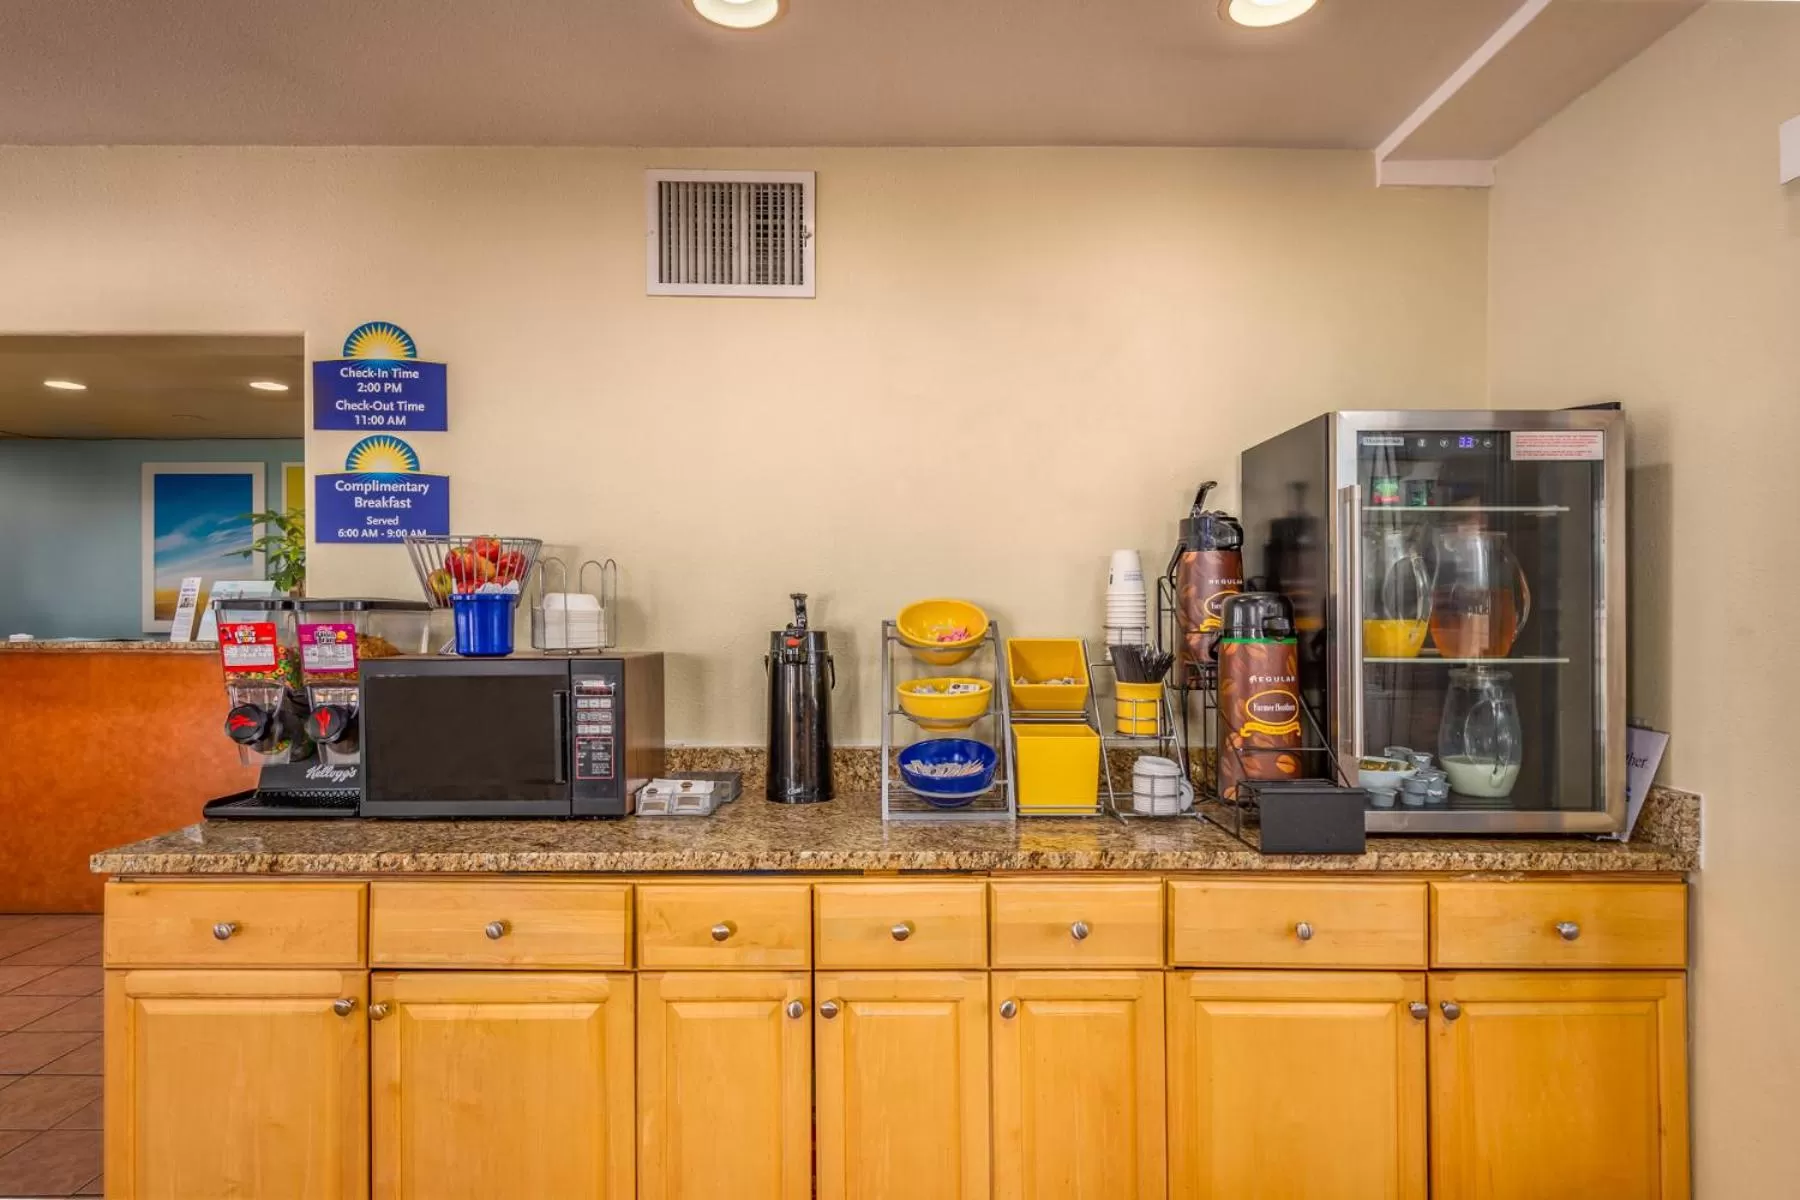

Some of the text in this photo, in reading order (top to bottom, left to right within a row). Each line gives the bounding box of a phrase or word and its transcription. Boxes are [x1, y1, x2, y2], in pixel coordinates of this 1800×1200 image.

[339, 367, 420, 379] Check-In Time
[356, 382, 402, 393] 2:00 PM
[335, 399, 425, 412] Check-Out Time
[354, 415, 407, 426] 11:00 AM
[335, 479, 430, 495] Complimentary
[354, 496, 412, 509] Breakfast
[366, 515, 400, 526] Served
[337, 528, 359, 538] 6:00
[361, 528, 378, 538] AM
[386, 528, 407, 538] 9:00
[409, 528, 427, 537] AM
[1249, 675, 1295, 684] REGULAR
[305, 764, 358, 782] Kellogg's
